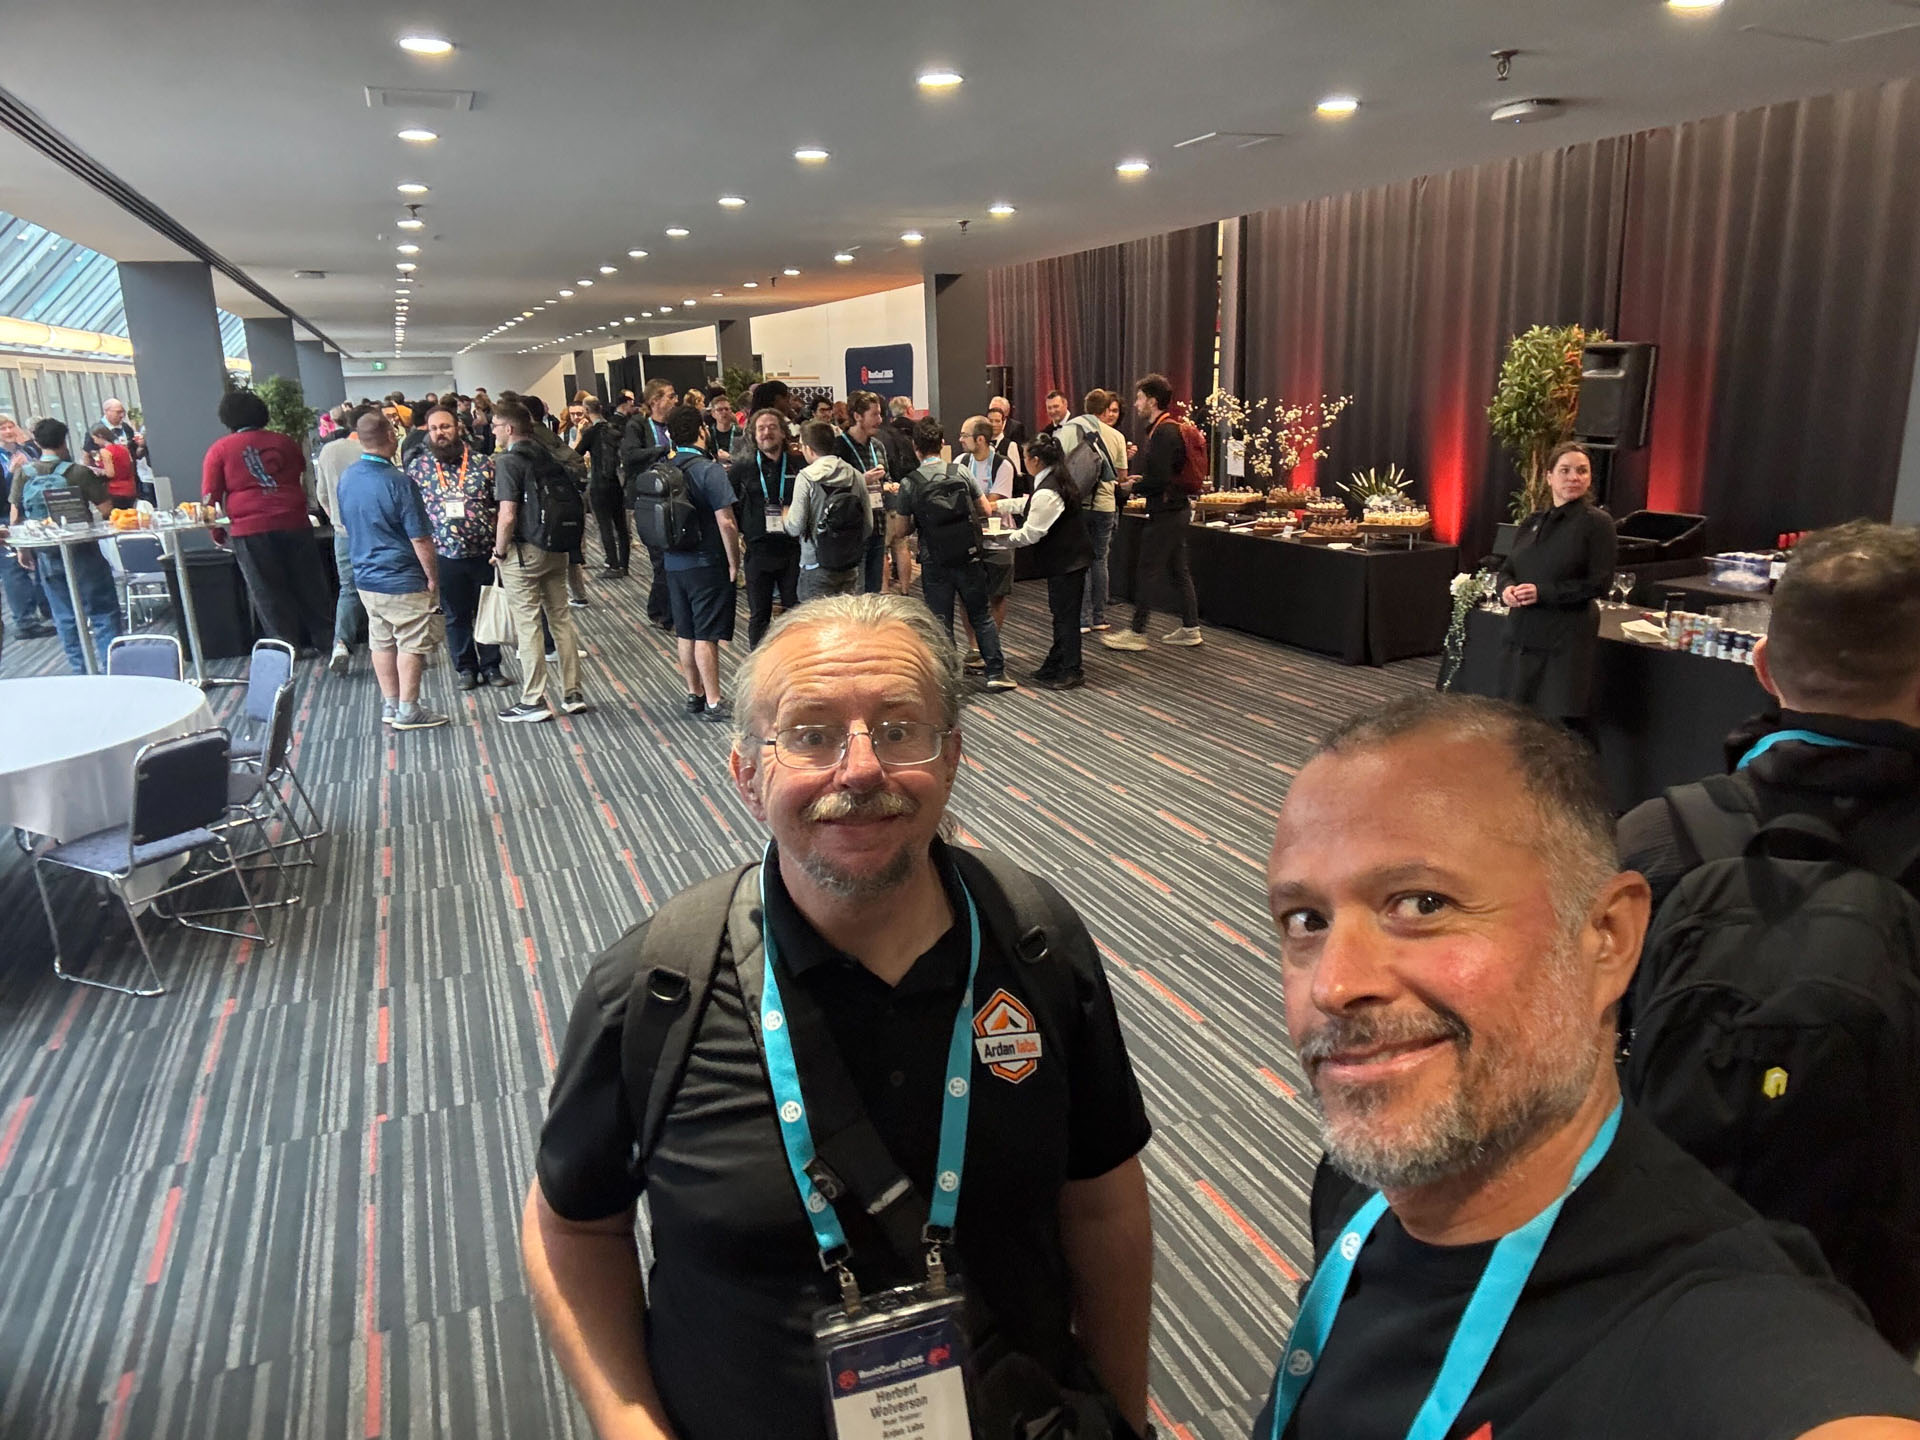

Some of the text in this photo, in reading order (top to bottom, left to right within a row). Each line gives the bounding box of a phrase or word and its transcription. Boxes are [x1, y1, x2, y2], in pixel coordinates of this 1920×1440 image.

[984, 1041, 1016, 1058] Ardan
[876, 1382, 918, 1403] Herbert
[870, 1395, 928, 1419] Wolverson
